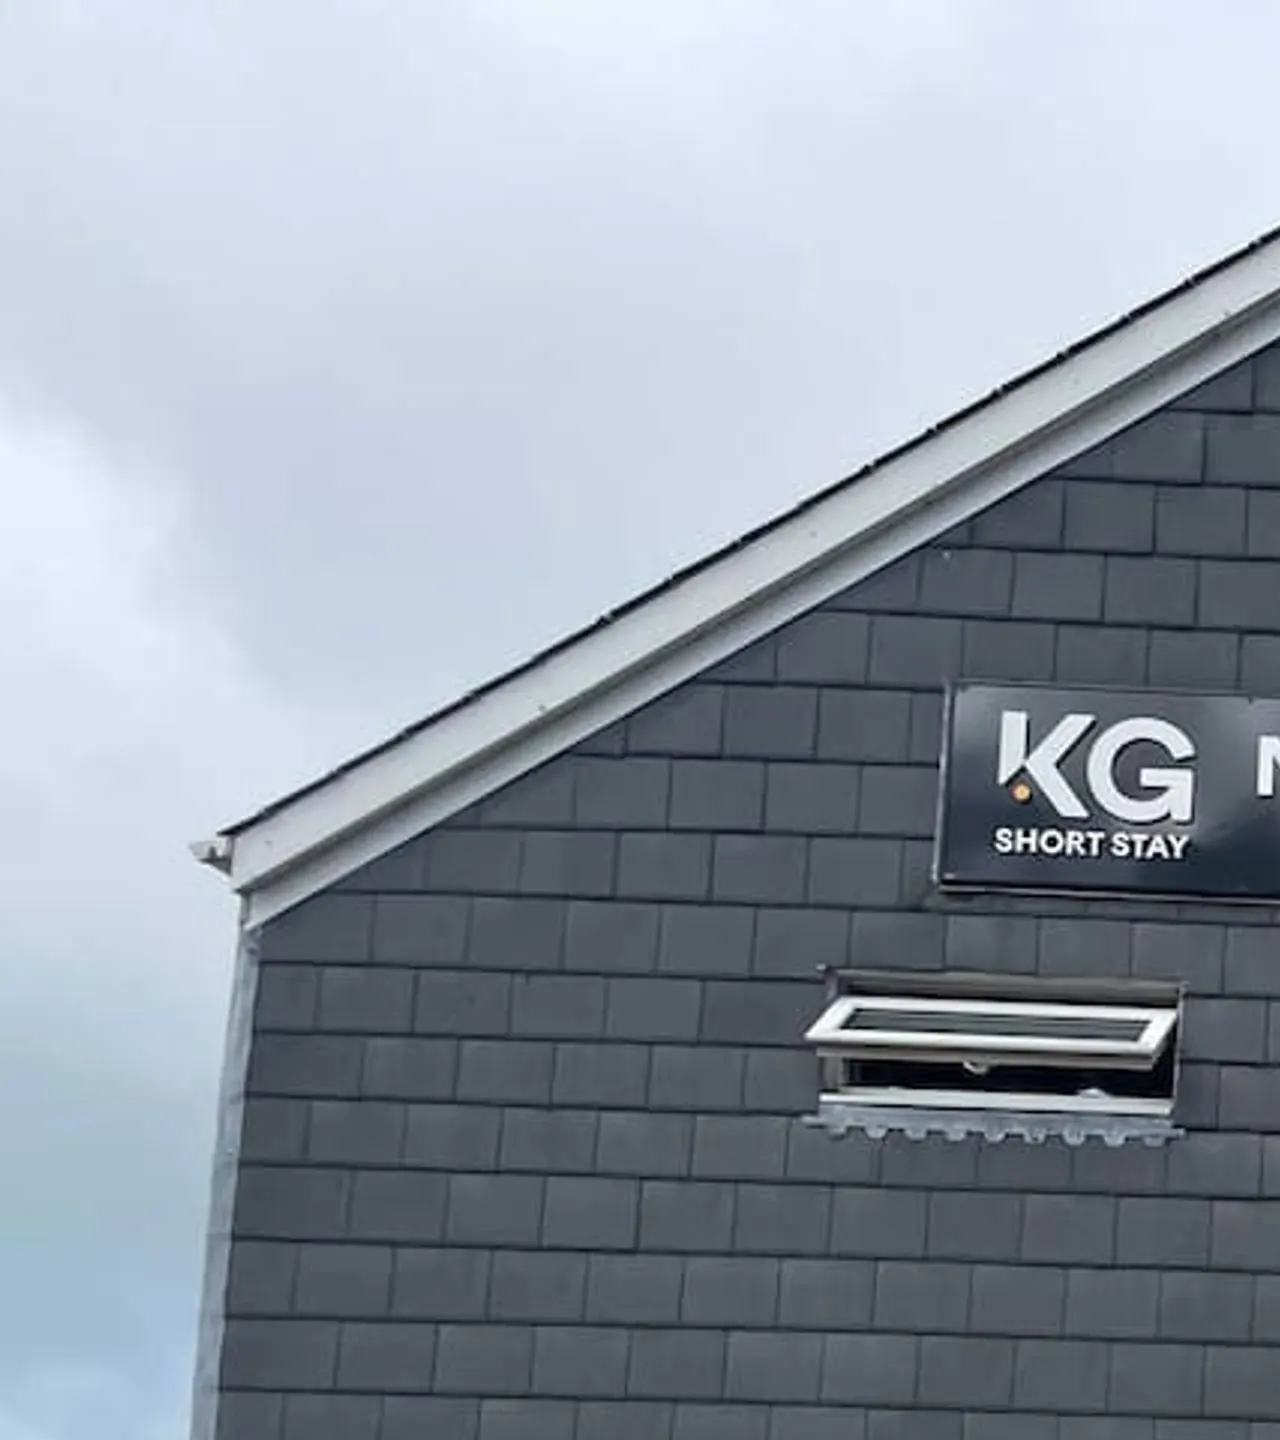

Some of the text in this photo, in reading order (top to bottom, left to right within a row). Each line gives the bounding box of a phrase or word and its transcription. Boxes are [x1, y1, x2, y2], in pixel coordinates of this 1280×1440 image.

[998, 711, 1196, 824] KG
[994, 827, 1190, 859] SHORT STAY
